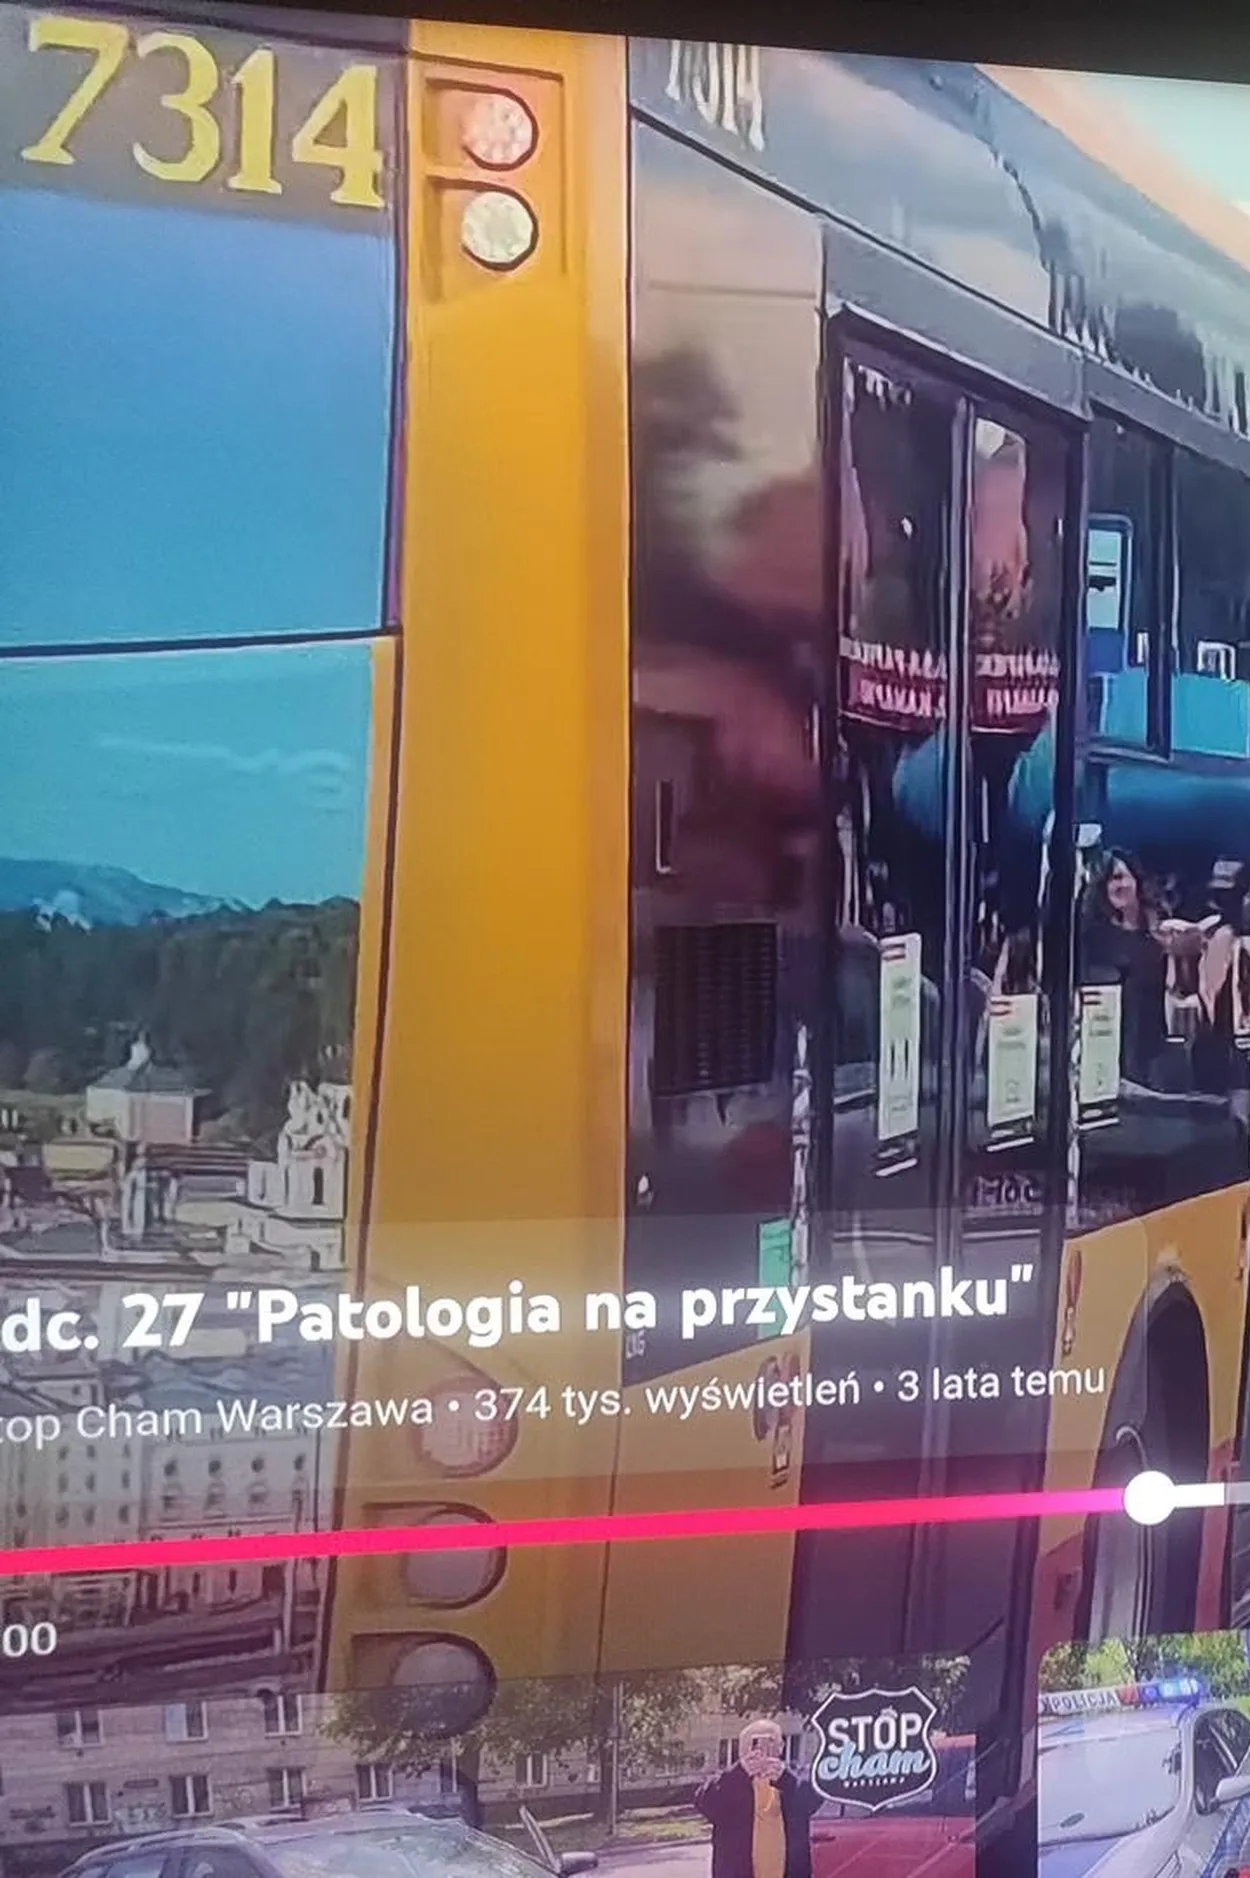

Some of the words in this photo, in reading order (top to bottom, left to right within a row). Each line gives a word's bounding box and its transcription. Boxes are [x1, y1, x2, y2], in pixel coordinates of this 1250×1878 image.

[21, 16, 386, 208] 7314
[1, 1298, 99, 1352] dc.
[121, 1292, 205, 1348] 27
[226, 1280, 561, 1348] "Patologia
[585, 1290, 657, 1330] na
[682, 1264, 1034, 1340] przystanku"
[76, 1403, 202, 1439] Cham
[217, 1397, 433, 1432] Warszawa
[474, 1386, 551, 1421] 374
[561, 1386, 632, 1424] tys.
[645, 1371, 860, 1420] wyświetleń
[897, 1370, 920, 1402] 3
[931, 1367, 1001, 1400] lata
[1010, 1365, 1105, 1396] temu
[2, 1621, 57, 1657] 00
[828, 1711, 923, 1754] STOP
